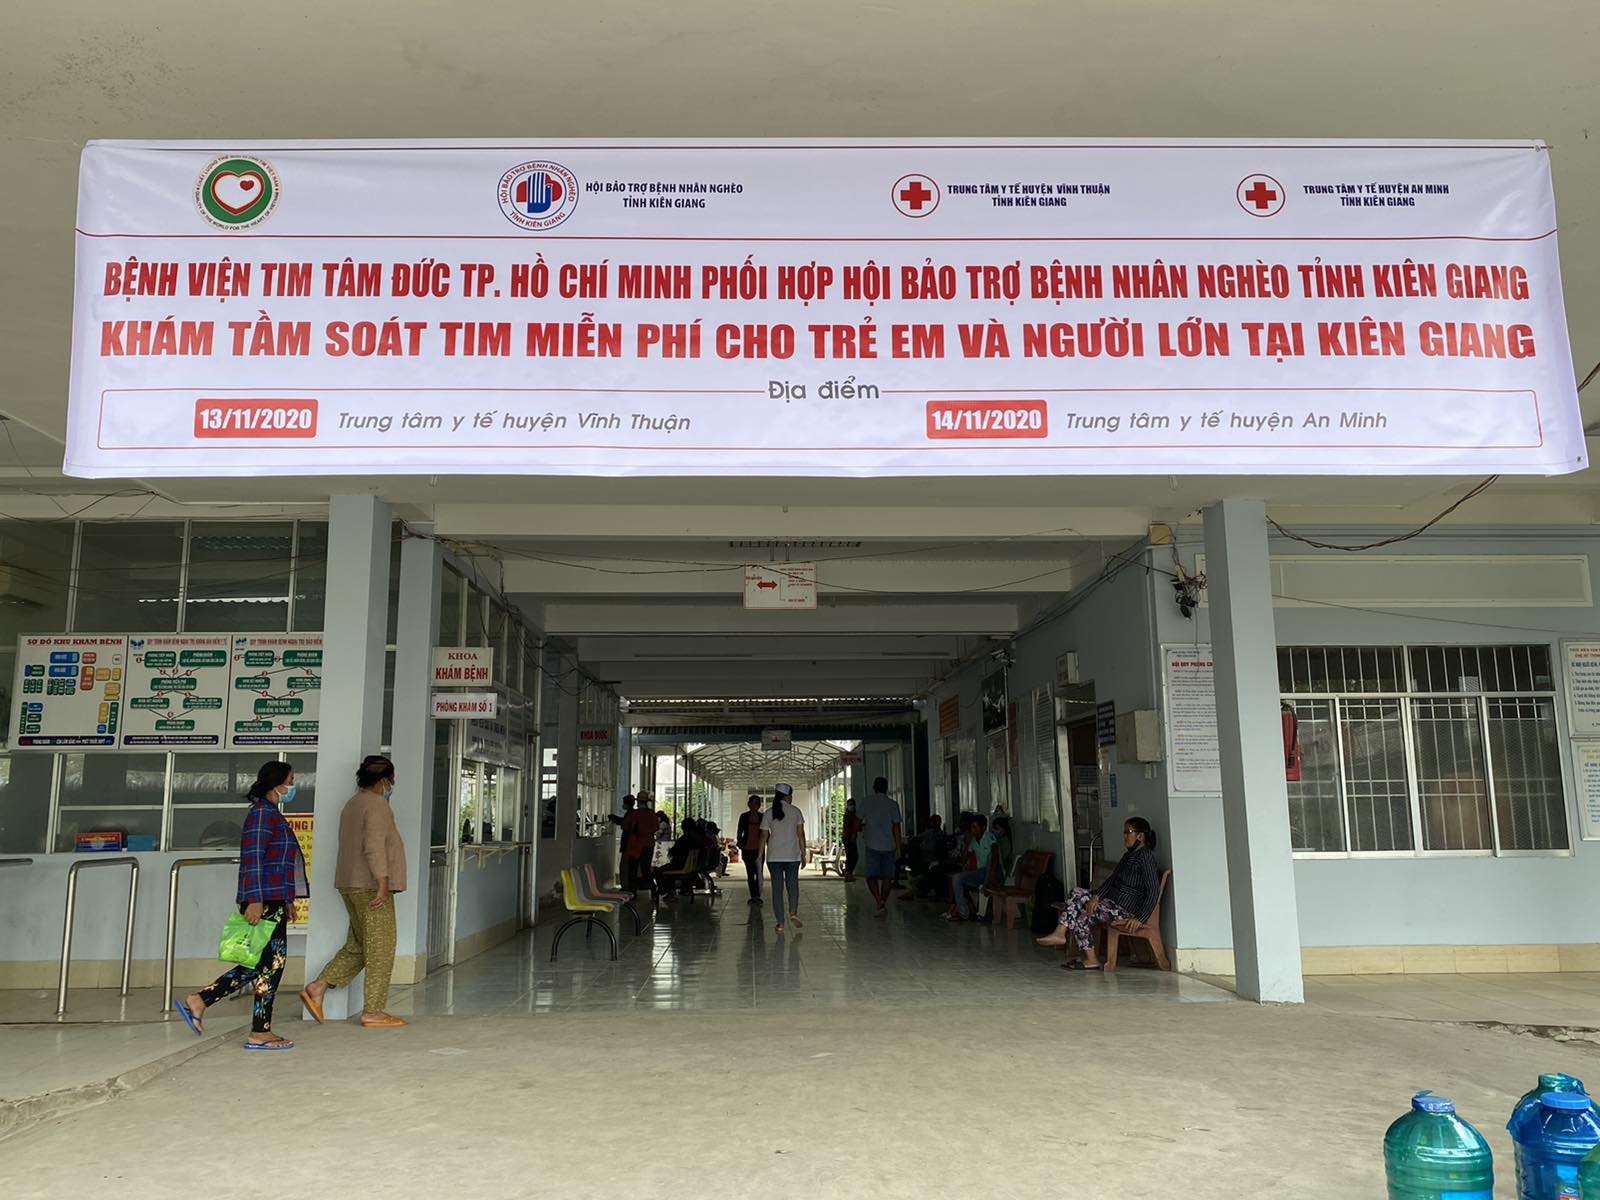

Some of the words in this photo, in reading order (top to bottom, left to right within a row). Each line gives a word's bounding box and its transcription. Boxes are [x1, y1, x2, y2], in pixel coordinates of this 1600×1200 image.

[549, 165, 569, 178] NHÂN
[586, 181, 603, 194] HỘI
[606, 181, 625, 192] BẢO
[628, 183, 647, 195] TRỢ
[650, 182, 676, 195] BỆNH
[679, 182, 706, 193] NHÂN
[710, 182, 743, 193] NGHÈO
[948, 184, 978, 195] TRUNG
[979, 183, 999, 195] TÂM
[1000, 184, 1007, 195] Y
[1009, 182, 1021, 195] TẾ
[1022, 182, 1053, 196] HUYỆN
[1056, 183, 1079, 195] VĨNH
[1081, 183, 1111, 196] THUẬN
[1303, 184, 1334, 195] TRUNG
[1335, 183, 1356, 195] TÂM
[1357, 184, 1364, 195] Y
[1365, 182, 1377, 195] TẾ
[1379, 182, 1410, 196] HUYỆN
[1411, 184, 1424, 195] AN
[1425, 184, 1450, 195] MINH
[623, 194, 647, 207] TỈNH
[650, 195, 673, 207] KIÊN
[675, 198, 706, 208] GIANG
[992, 194, 1013, 206] TỈNH
[1015, 196, 1037, 206] KIÊN
[1039, 197, 1067, 207] GIANG
[1340, 194, 1362, 206] TỈNH
[1363, 195, 1385, 206] KIÊN
[1387, 197, 1415, 207] GIANG
[525, 220, 543, 228] KIÊN
[544, 211, 566, 226] GIANG
[104, 255, 178, 302] BỆNH
[189, 255, 250, 303] VIỆN
[261, 262, 312, 297] TIM
[322, 256, 382, 297] TÂM
[391, 257, 450, 298] ĐỨC
[460, 263, 501, 299] TP.
[511, 252, 548, 299] HỒ
[560, 258, 609, 299] CHÍ
[618, 264, 692, 300] MINH
[702, 254, 767, 301] PHỐI
[778, 260, 834, 307] HỢP
[844, 259, 891, 307] HỘI
[901, 257, 957, 301] BẢO
[966, 260, 1021, 306] TRỢ
[1031, 258, 1102, 306] BỆNH
[1113, 258, 1188, 299] NHÂN
[1198, 259, 1290, 299] NGHÈO
[1298, 256, 1364, 299] TỈNH
[1373, 257, 1437, 298] KIÊN
[1446, 263, 1530, 301] GIANG
[101, 315, 214, 357] KHÁM
[229, 310, 311, 356] TẦM
[326, 316, 427, 357] SOÁT
[440, 321, 511, 357] TIM
[527, 312, 622, 358] MIỄN
[638, 318, 702, 359] PHÍ
[716, 323, 795, 360] CHO
[808, 315, 878, 359] TRẺ
[892, 324, 944, 359] EM
[958, 318, 1010, 358] VÀ
[1023, 316, 1143, 358] NGƯỜI
[1159, 316, 1229, 357] LỚN
[1242, 322, 1305, 363] TẠI
[1318, 315, 1405, 356] KIÊN
[1420, 321, 1536, 359] GIANG
[768, 380, 806, 402] Địa
[818, 375, 879, 400] điểm
[200, 408, 313, 429] 13/11/2020
[340, 413, 393, 432] Trung
[402, 412, 441, 428] tâm
[452, 417, 465, 432] y
[473, 411, 498, 428] tế
[504, 413, 567, 432] huyện
[578, 413, 620, 429] Vĩnh
[631, 415, 690, 434] Thuận
[931, 408, 1042, 430] 14/11/2020
[1067, 413, 1120, 432] Trung
[1130, 412, 1170, 428] tâm
[1180, 417, 1192, 431] y
[1201, 411, 1224, 428] tế
[1231, 413, 1293, 431] huyện
[1303, 413, 1331, 428] An
[1340, 413, 1387, 428] Minh
[435, 664, 462, 680] KHÁM
[464, 664, 488, 682] BỆNH
[436, 700, 457, 712] PHÒNG
[478, 698, 488, 712] SỐ
